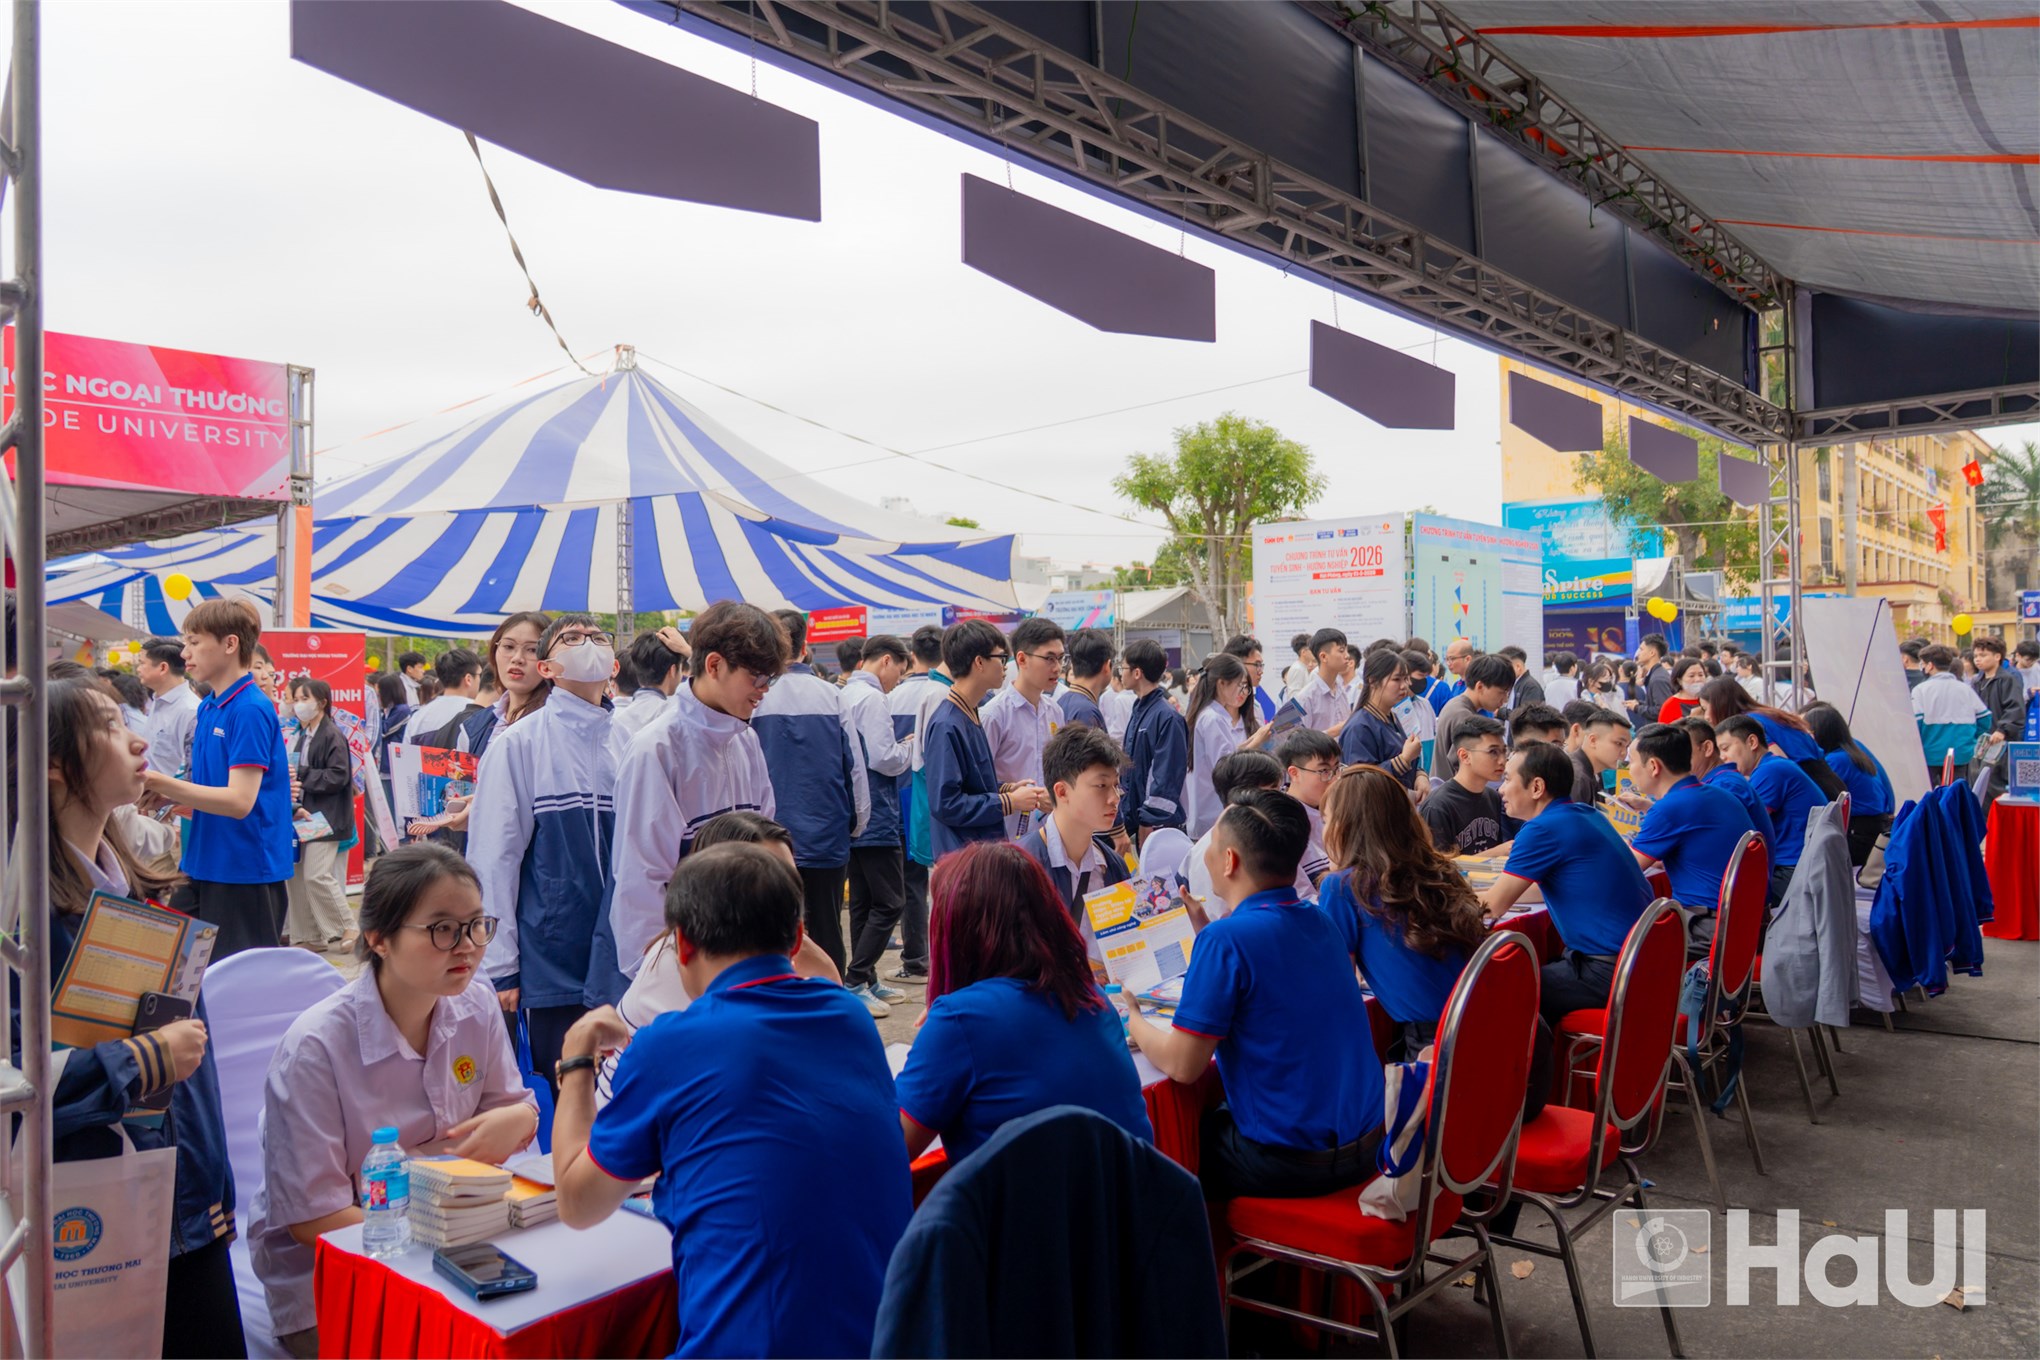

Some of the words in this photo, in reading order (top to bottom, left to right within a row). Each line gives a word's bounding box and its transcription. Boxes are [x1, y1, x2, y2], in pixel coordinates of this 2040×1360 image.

[66, 373, 161, 407] NGOẠI
[168, 387, 285, 417] THƯƠNG
[98, 413, 288, 449] UNIVERSITY
[1350, 545, 1383, 567] 2026
[55, 1270, 79, 1280] HỌC
[81, 1263, 123, 1277] THƯƠNG
[68, 1275, 119, 1289] UNIVERSITY
